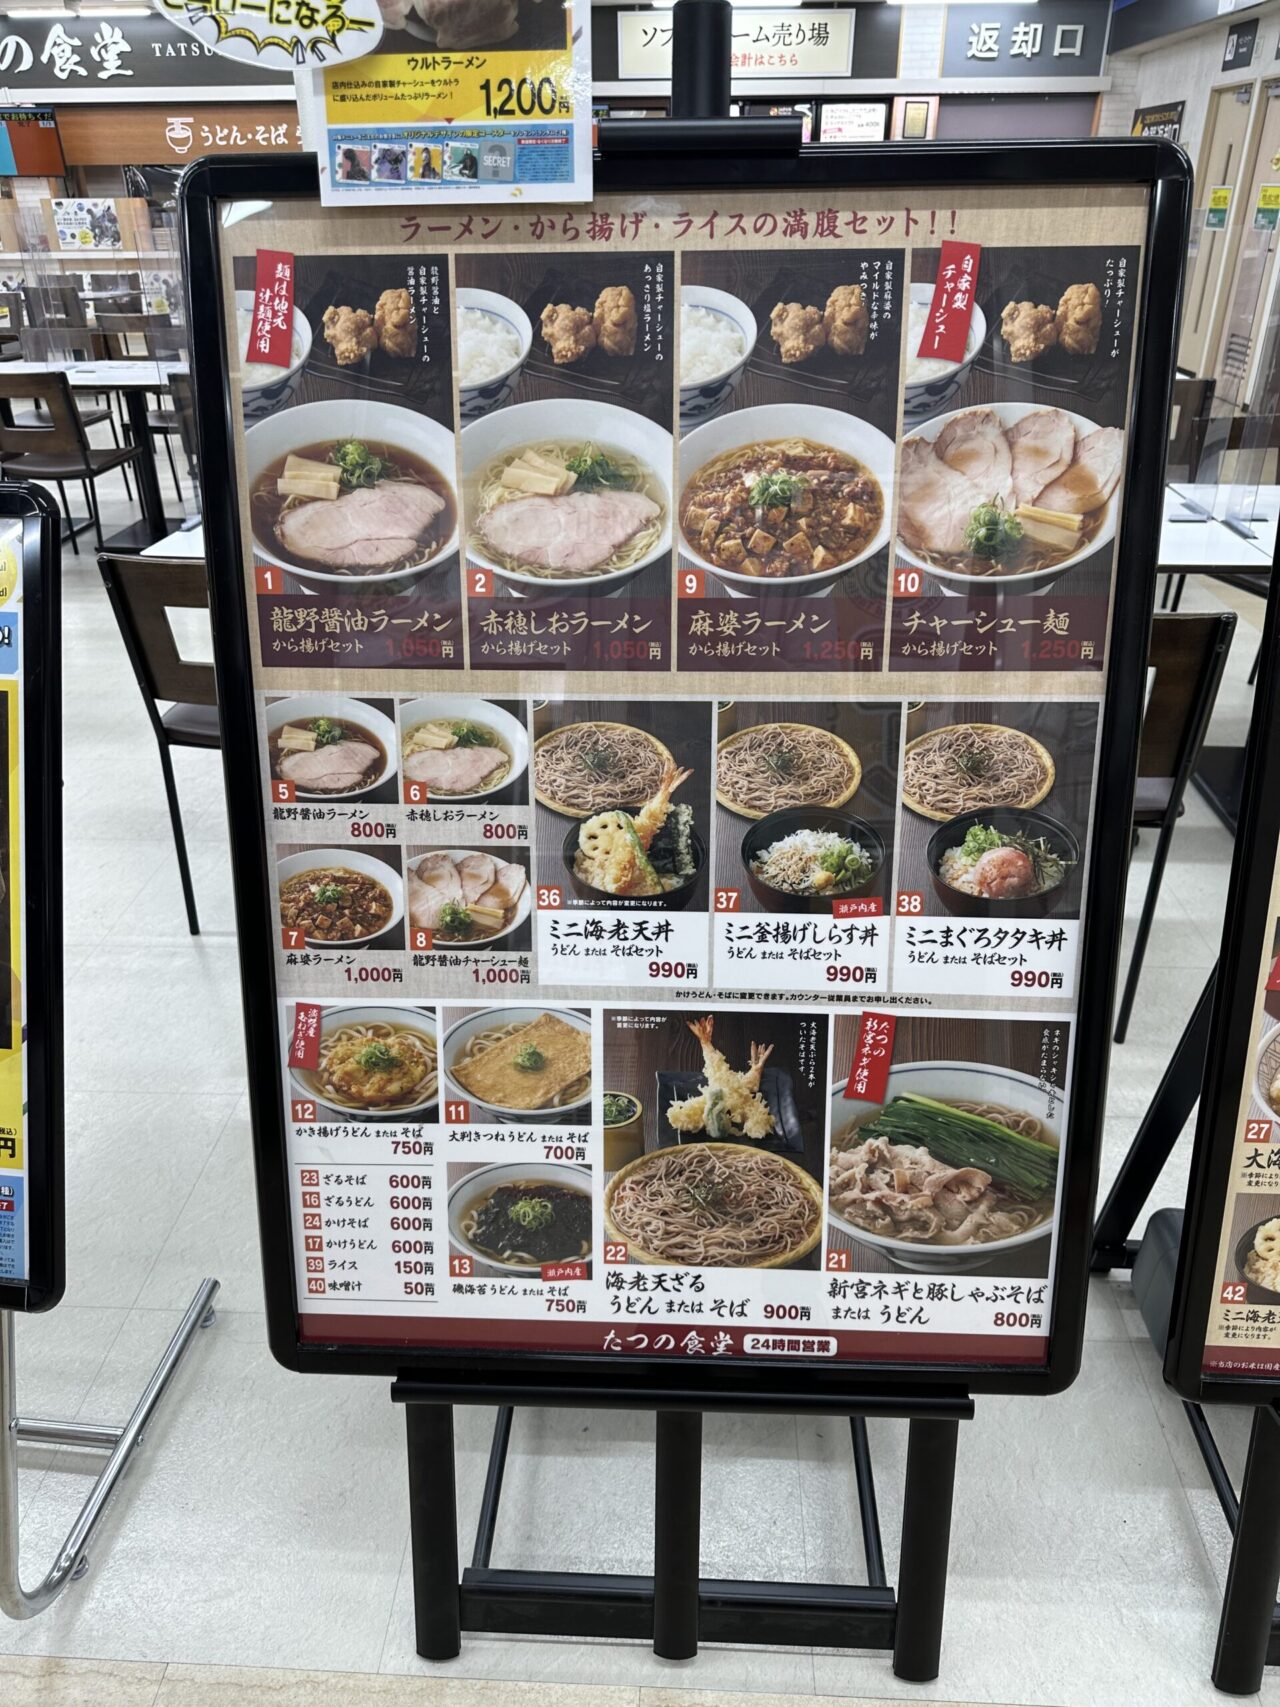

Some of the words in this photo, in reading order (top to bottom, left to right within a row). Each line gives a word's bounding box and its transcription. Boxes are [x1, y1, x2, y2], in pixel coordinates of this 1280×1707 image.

[966, 22, 1085, 59] 返却口
[0, 22, 135, 80] の食堂
[152, 43, 220, 57] TATSU
[407, 56, 488, 72] ウルトラーメン
[200, 124, 288, 147] うどん・そば
[483, 154, 511, 168] SECRET
[951, 254, 974, 311] 自家製
[934, 263, 957, 350] チャーシュー
[264, 571, 273, 590] 1
[474, 573, 486, 592] 2
[685, 574, 697, 594] 9
[897, 573, 919, 593] 10
[269, 606, 453, 633] 龍野醤油ラーメン
[479, 609, 653, 636] 赤穂しおラーメン
[688, 609, 832, 637] 麻婆ラーメン
[902, 608, 1070, 636] チャーシュー麺
[272, 637, 364, 654] から揚げセット
[480, 640, 572, 656] から揚げセット
[688, 641, 781, 658] から揚げセット
[901, 640, 998, 657] から揚げセット
[278, 783, 289, 799] 5
[410, 785, 421, 801] 6
[272, 807, 369, 821] 龍野醤油ラーメン
[406, 808, 499, 822] 赤穂しおラーメン
[351, 822, 397, 838] 800円
[483, 824, 528, 840] 800円
[538, 889, 560, 907] 36
[716, 892, 738, 909] 37
[898, 895, 921, 913] 38
[289, 931, 298, 945] 7
[549, 918, 675, 943] ミニ海老天丼
[724, 921, 879, 947] ミニ釜揚げしらす丼
[905, 925, 1068, 952] ミニまぐろタタキ丼
[416, 932, 427, 947] 8
[551, 943, 580, 957] うどん
[584, 947, 607, 957] または
[610, 944, 664, 958] そばセット
[727, 946, 757, 960] うどん
[760, 951, 784, 960] または
[787, 948, 842, 962] そばセット
[907, 950, 939, 964] うどん
[942, 955, 967, 965] または
[971, 952, 1028, 967] そばセット
[285, 953, 356, 966] 麻婆ラーメン
[412, 953, 529, 968] 龍野醤油チャーシュー麺
[344, 967, 403, 984] 1,000円
[472, 968, 530, 984] 1,000円
[649, 961, 698, 980] 990円
[826, 965, 877, 984] 990円
[1010, 970, 1063, 989] 990円
[295, 1103, 314, 1119] 12
[448, 1105, 465, 1120] 11
[295, 1126, 371, 1138] かき揚げうどん
[375, 1129, 398, 1138] または
[400, 1126, 424, 1138] そば
[448, 1130, 537, 1143] 大判きつねうどん
[541, 1134, 564, 1143] または
[566, 1131, 590, 1143] そば
[1247, 1123, 1270, 1139] 27
[391, 1140, 434, 1156] 750円
[543, 1145, 586, 1161] 700円
[302, 1172, 317, 1185] 23
[322, 1173, 367, 1186] ざるそば
[388, 1174, 432, 1189] 600円
[304, 1194, 319, 1206] 16
[324, 1195, 374, 1208] ざるうどん
[389, 1195, 432, 1210] 600円
[305, 1215, 321, 1228] 24
[324, 1217, 370, 1229] かけそば
[390, 1216, 433, 1231] 600円
[307, 1237, 321, 1249] 17
[326, 1239, 377, 1250] かけうどん
[391, 1240, 434, 1255] 600円
[606, 1245, 626, 1261] 22
[307, 1259, 323, 1271] 39
[327, 1259, 358, 1271] ライス
[394, 1260, 434, 1275] 150円
[452, 1259, 471, 1274] 13
[828, 1252, 847, 1269] 21
[309, 1279, 324, 1292] 40
[327, 1280, 362, 1292] 味噌汁
[403, 1281, 435, 1296] 50円
[522, 1287, 544, 1296] または
[547, 1284, 570, 1296] そば
[605, 1270, 705, 1293] 海老天ざる
[827, 1277, 1048, 1305] 新宮ネギと豚しゃぶそば
[1222, 1285, 1245, 1301] 42
[545, 1298, 587, 1314] 750円
[609, 1295, 660, 1315] うどん
[665, 1299, 704, 1314] または
[709, 1298, 751, 1318] そば
[763, 1303, 811, 1321] 900円
[831, 1305, 870, 1321] または
[879, 1305, 930, 1325] うどん
[993, 1311, 1043, 1328] 800円
[1222, 1309, 1280, 1324] ミニ海老
[602, 1329, 735, 1356] たつの食堂
[751, 1337, 831, 1353] 24時間営業
